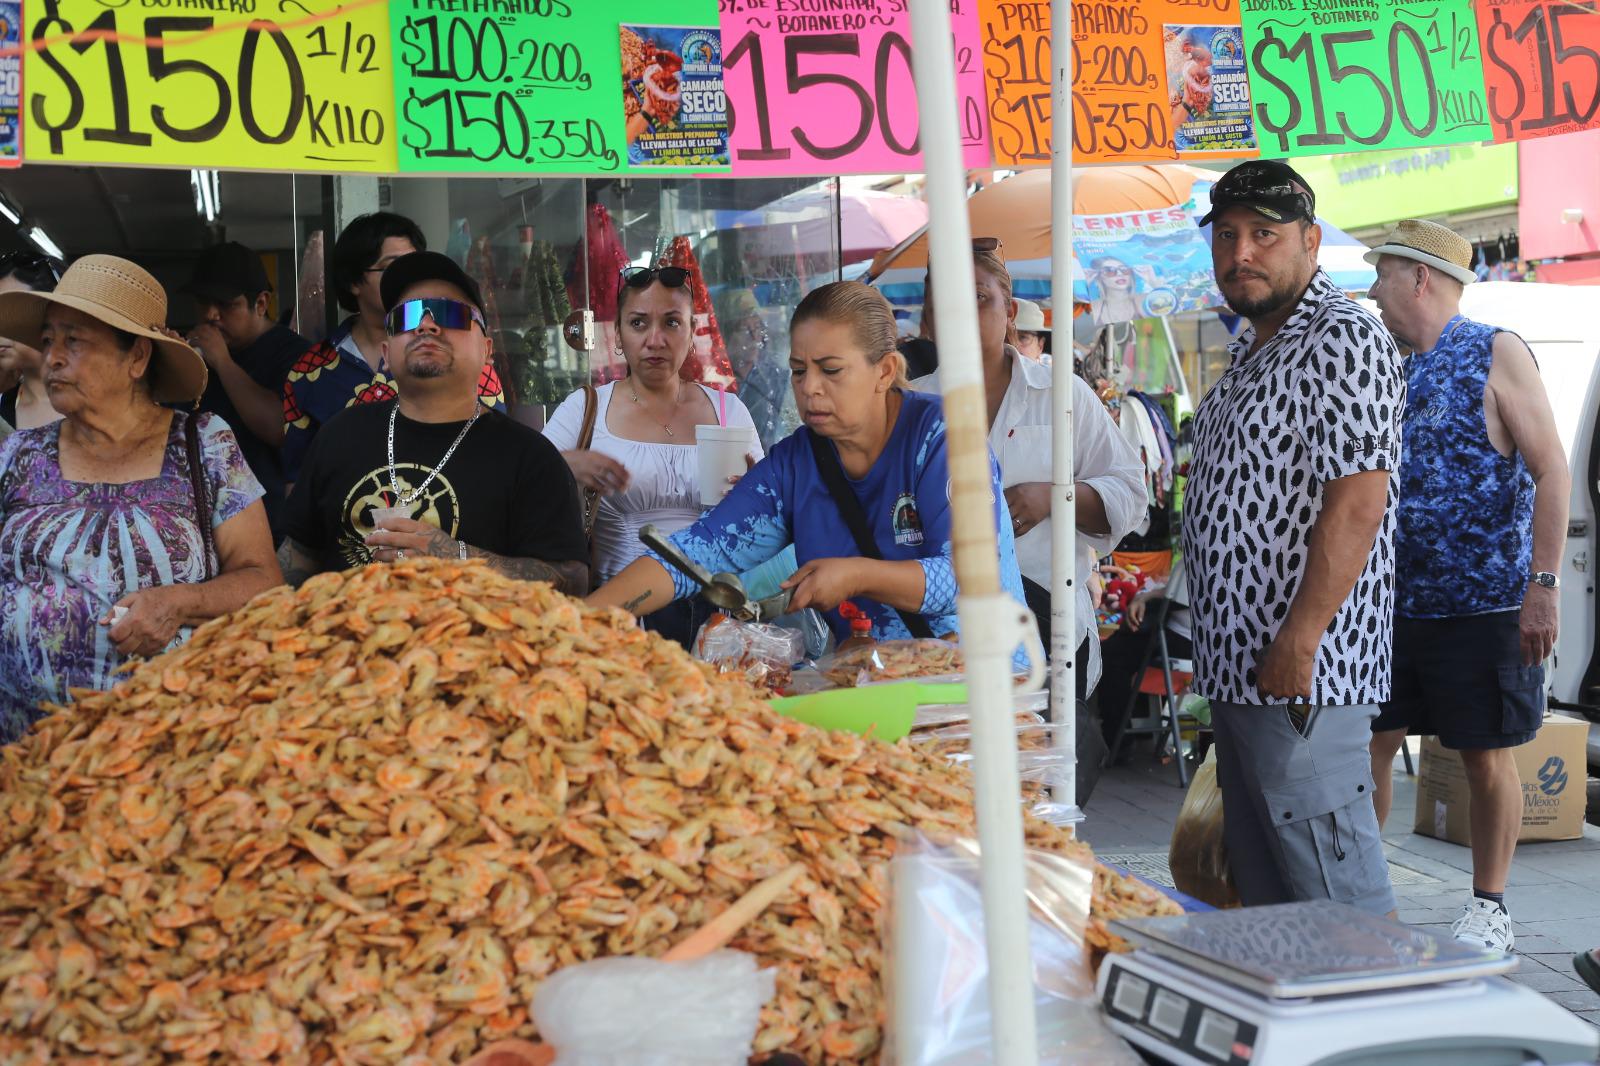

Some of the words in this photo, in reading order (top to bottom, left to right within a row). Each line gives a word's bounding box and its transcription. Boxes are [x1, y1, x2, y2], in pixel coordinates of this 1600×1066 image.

[778, 15, 867, 33] BOTANERO
[997, 3, 1148, 35] PREARADOS
[1312, 10, 1380, 25] BOTANERO
[305, 21, 380, 74] 1/2
[1426, 12, 1476, 70] 1/2
[31, 0, 306, 155] $150
[681, 77, 725, 91] CAMARÓN
[1212, 71, 1247, 84] CAMARÓN
[1252, 20, 1439, 152] $150
[682, 91, 727, 113] SECO
[722, 31, 921, 160] 150
[1213, 83, 1249, 103] SECO
[1438, 89, 1484, 124] KILO
[304, 94, 384, 148] KILO
[641, 140, 667, 150] LLEVAN
[668, 140, 687, 148] SALSA
[688, 139, 696, 148] DE
[697, 138, 705, 147] LA
[706, 138, 722, 146] CASA
[1524, 793, 1560, 807] México
